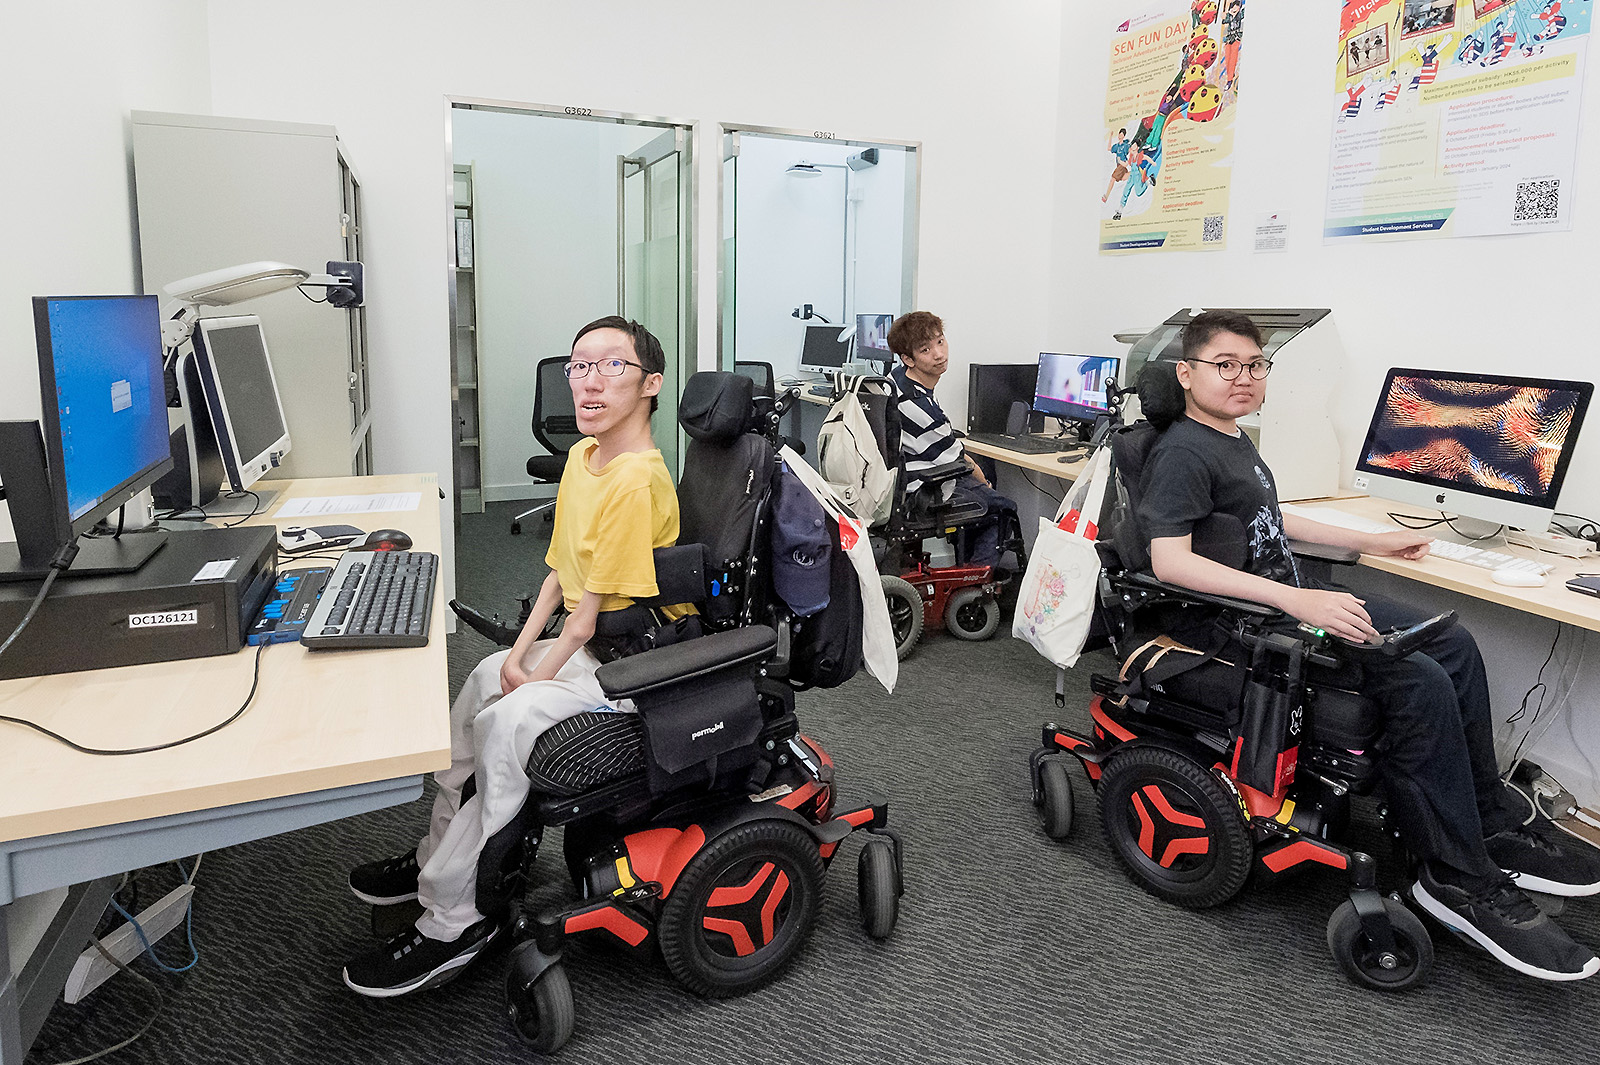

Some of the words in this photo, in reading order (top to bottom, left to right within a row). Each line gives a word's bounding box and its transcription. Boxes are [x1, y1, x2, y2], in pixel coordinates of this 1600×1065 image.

[1114, 40, 1134, 56] SEN
[1138, 30, 1160, 47] FUN
[1166, 20, 1188, 38] DAY
[1423, 85, 1448, 94] Maximum
[1450, 80, 1471, 89] amount
[1534, 65, 1544, 73] per
[1545, 60, 1570, 70] activity
[1422, 92, 1444, 101] Number
[1451, 86, 1476, 96] activities
[1448, 100, 1480, 110] Application
[565, 106, 592, 116] G3622
[814, 130, 836, 140] G3621
[1446, 127, 1478, 136] Application
[1445, 142, 1488, 152] Announcement
[1496, 136, 1522, 145] selected
[1443, 162, 1465, 170] Activity
[1380, 223, 1411, 232] Development
[132, 612, 194, 625] OC126121
[692, 721, 724, 740] permobil
